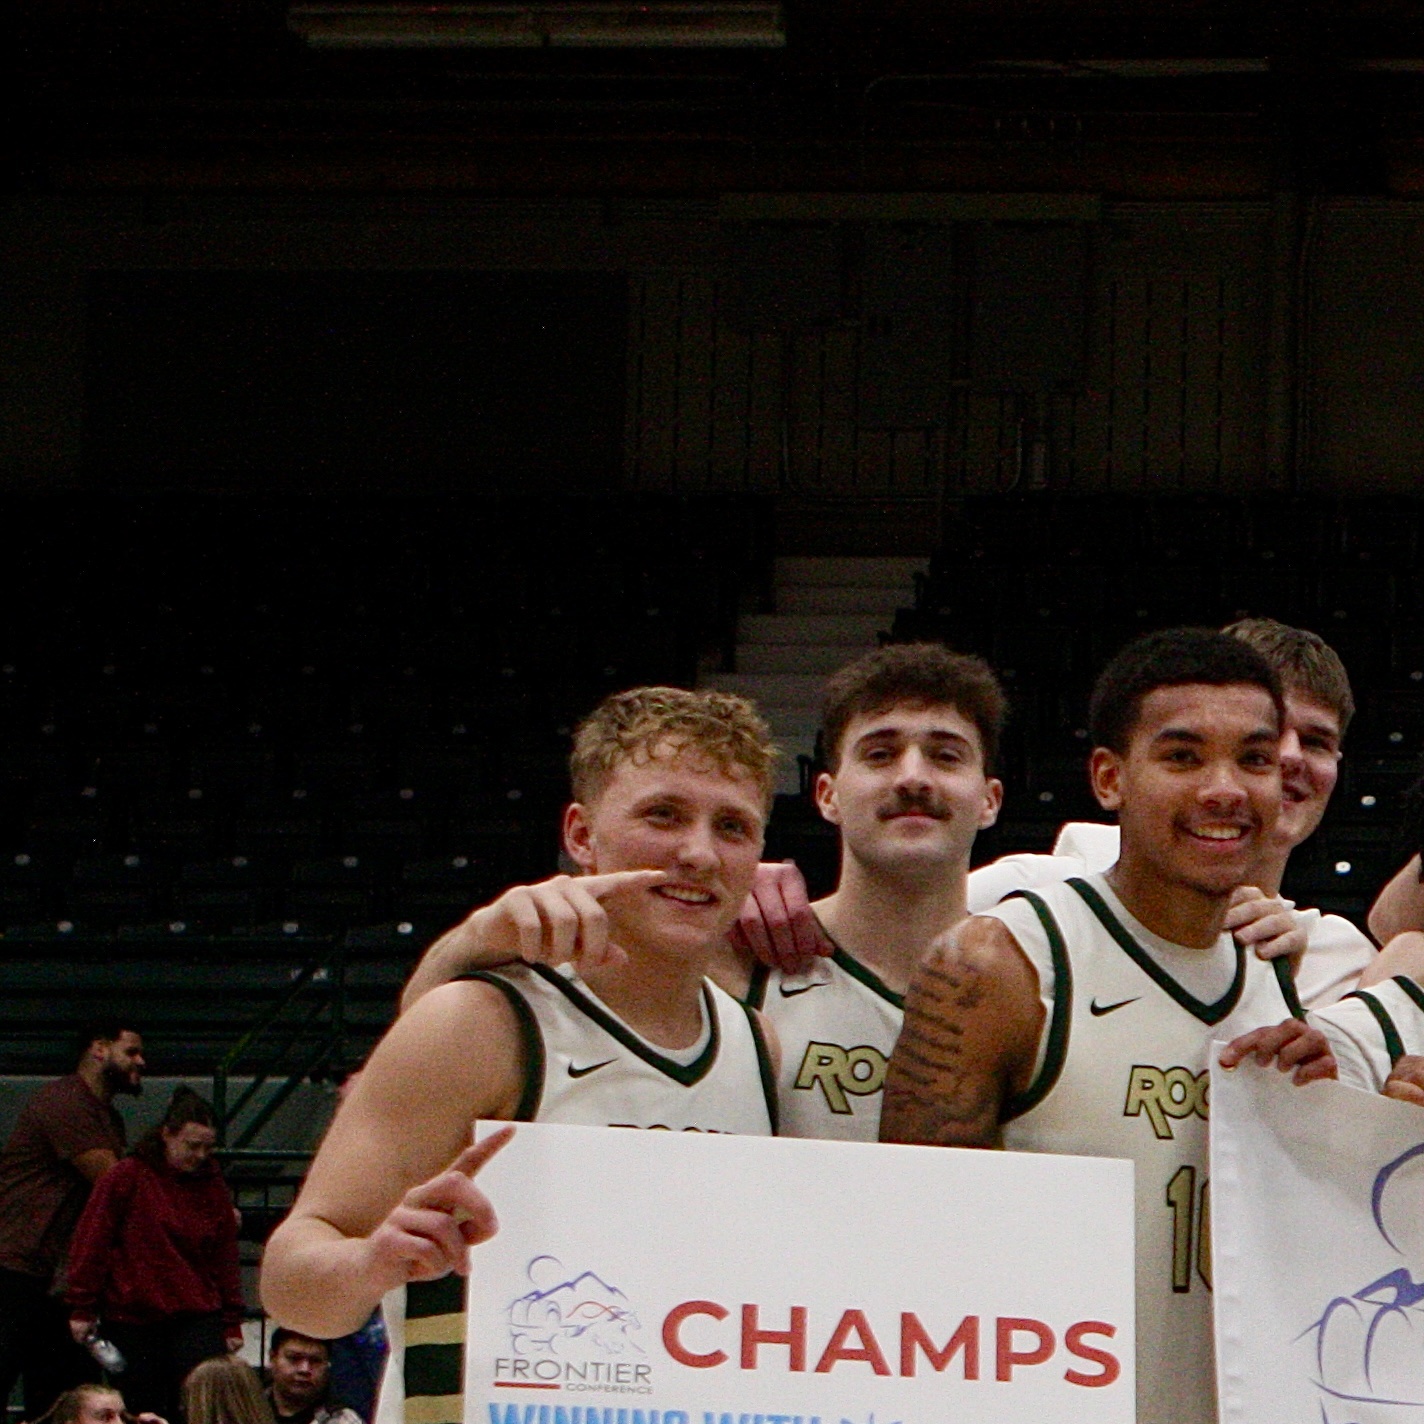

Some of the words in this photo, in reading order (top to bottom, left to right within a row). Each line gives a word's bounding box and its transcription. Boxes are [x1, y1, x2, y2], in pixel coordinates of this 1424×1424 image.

[794, 1041, 888, 1115] RO
[1167, 1165, 1212, 1293] 1
[495, 1358, 652, 1383] FRONTIER
[662, 1300, 1121, 1388] CHAMPS
